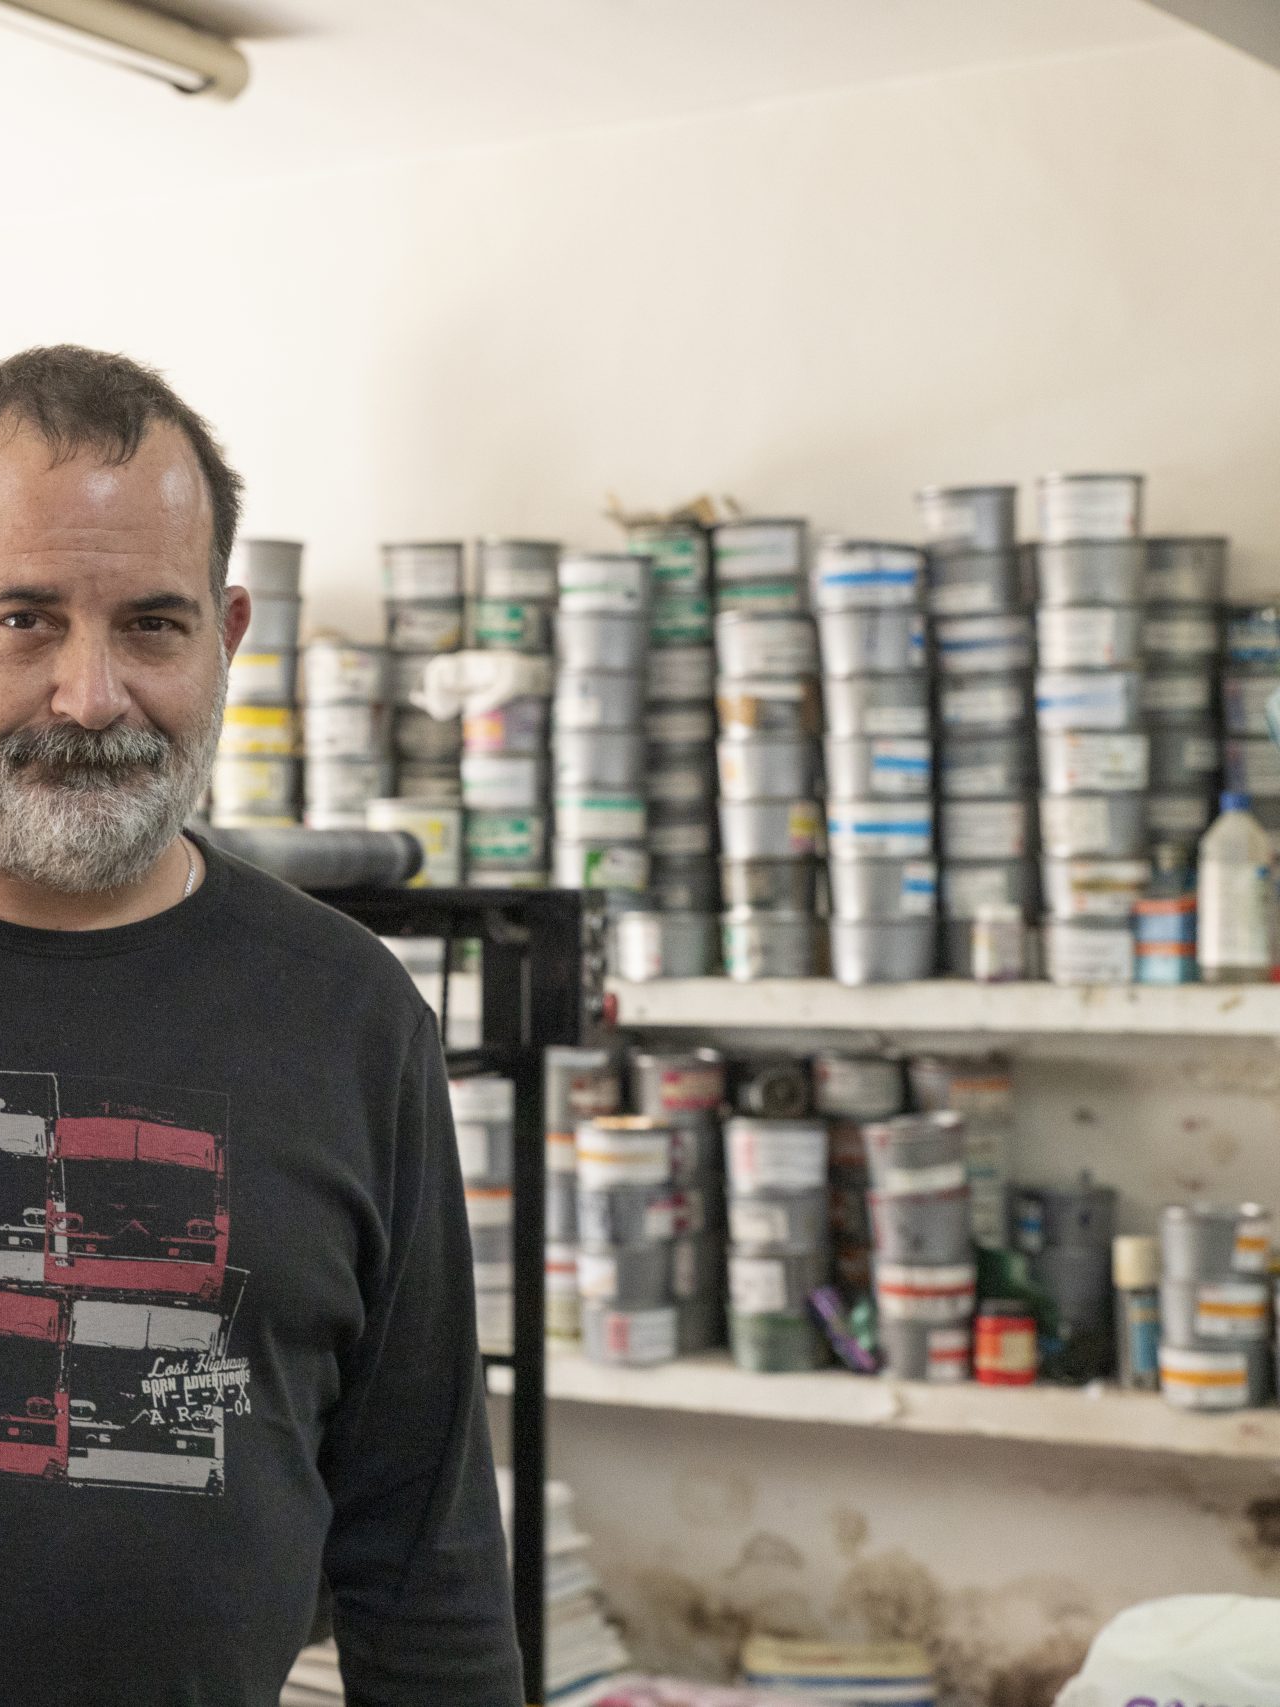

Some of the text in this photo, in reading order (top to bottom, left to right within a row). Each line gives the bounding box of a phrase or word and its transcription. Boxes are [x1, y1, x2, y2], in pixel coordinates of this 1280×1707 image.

[148, 1353, 250, 1378] Lost Highway
[141, 1369, 251, 1394] BORN ADVENTUROUS
